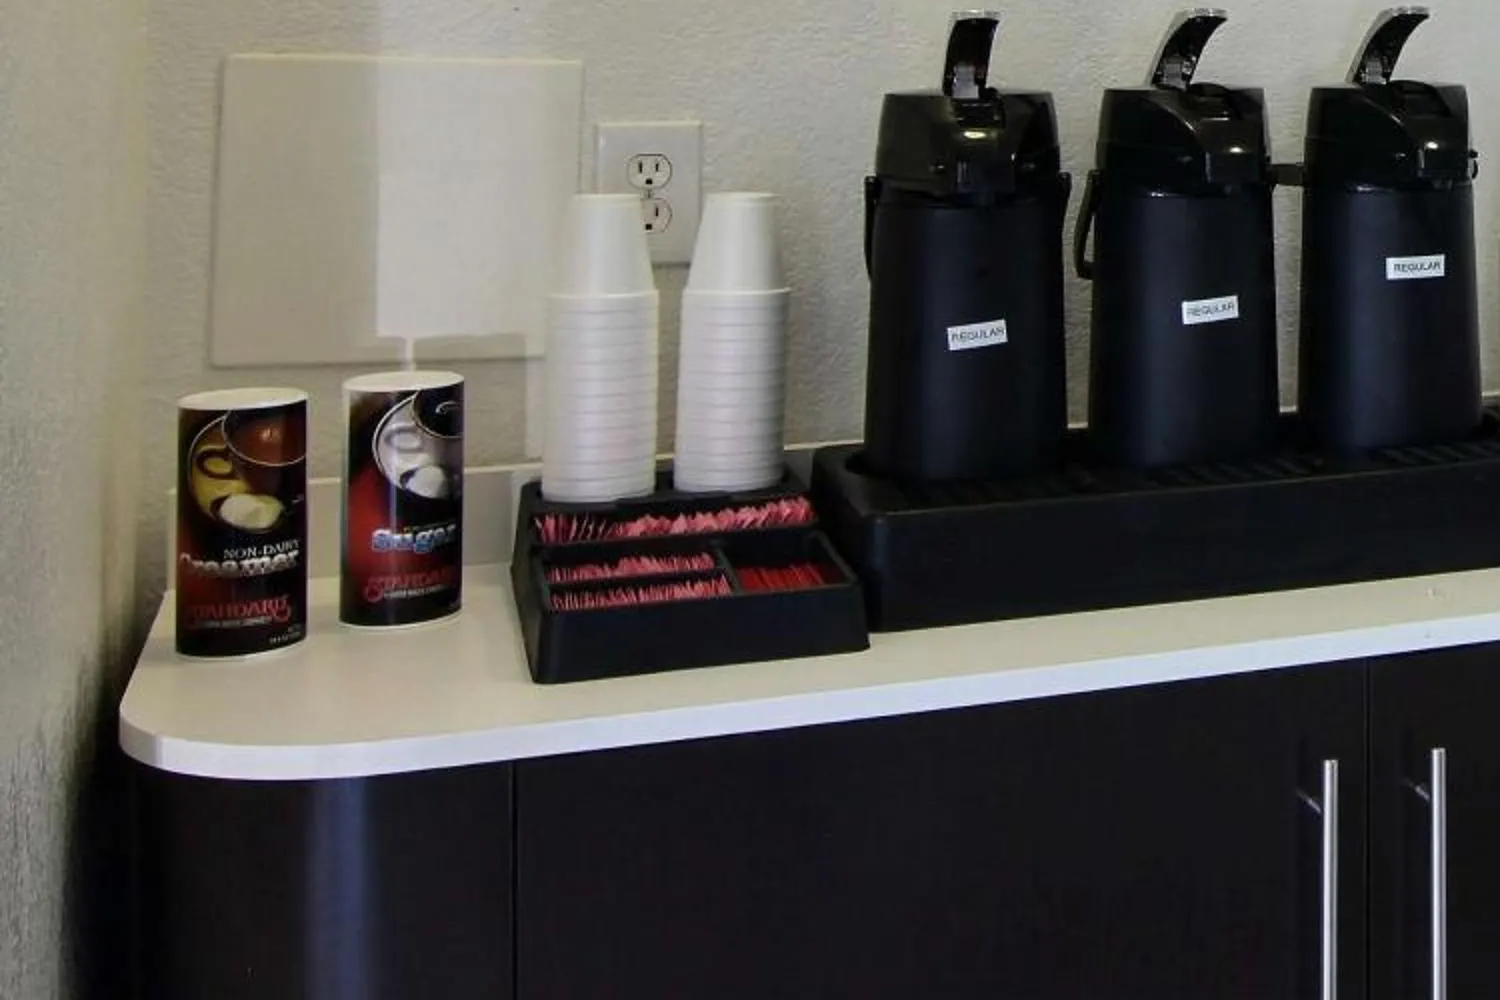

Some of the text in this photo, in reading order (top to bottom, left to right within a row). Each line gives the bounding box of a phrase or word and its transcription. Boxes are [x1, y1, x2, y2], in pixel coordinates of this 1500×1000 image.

[1393, 260, 1441, 273] REGULAR
[1186, 301, 1236, 318] REGULAR
[951, 326, 1005, 343] REGULAR
